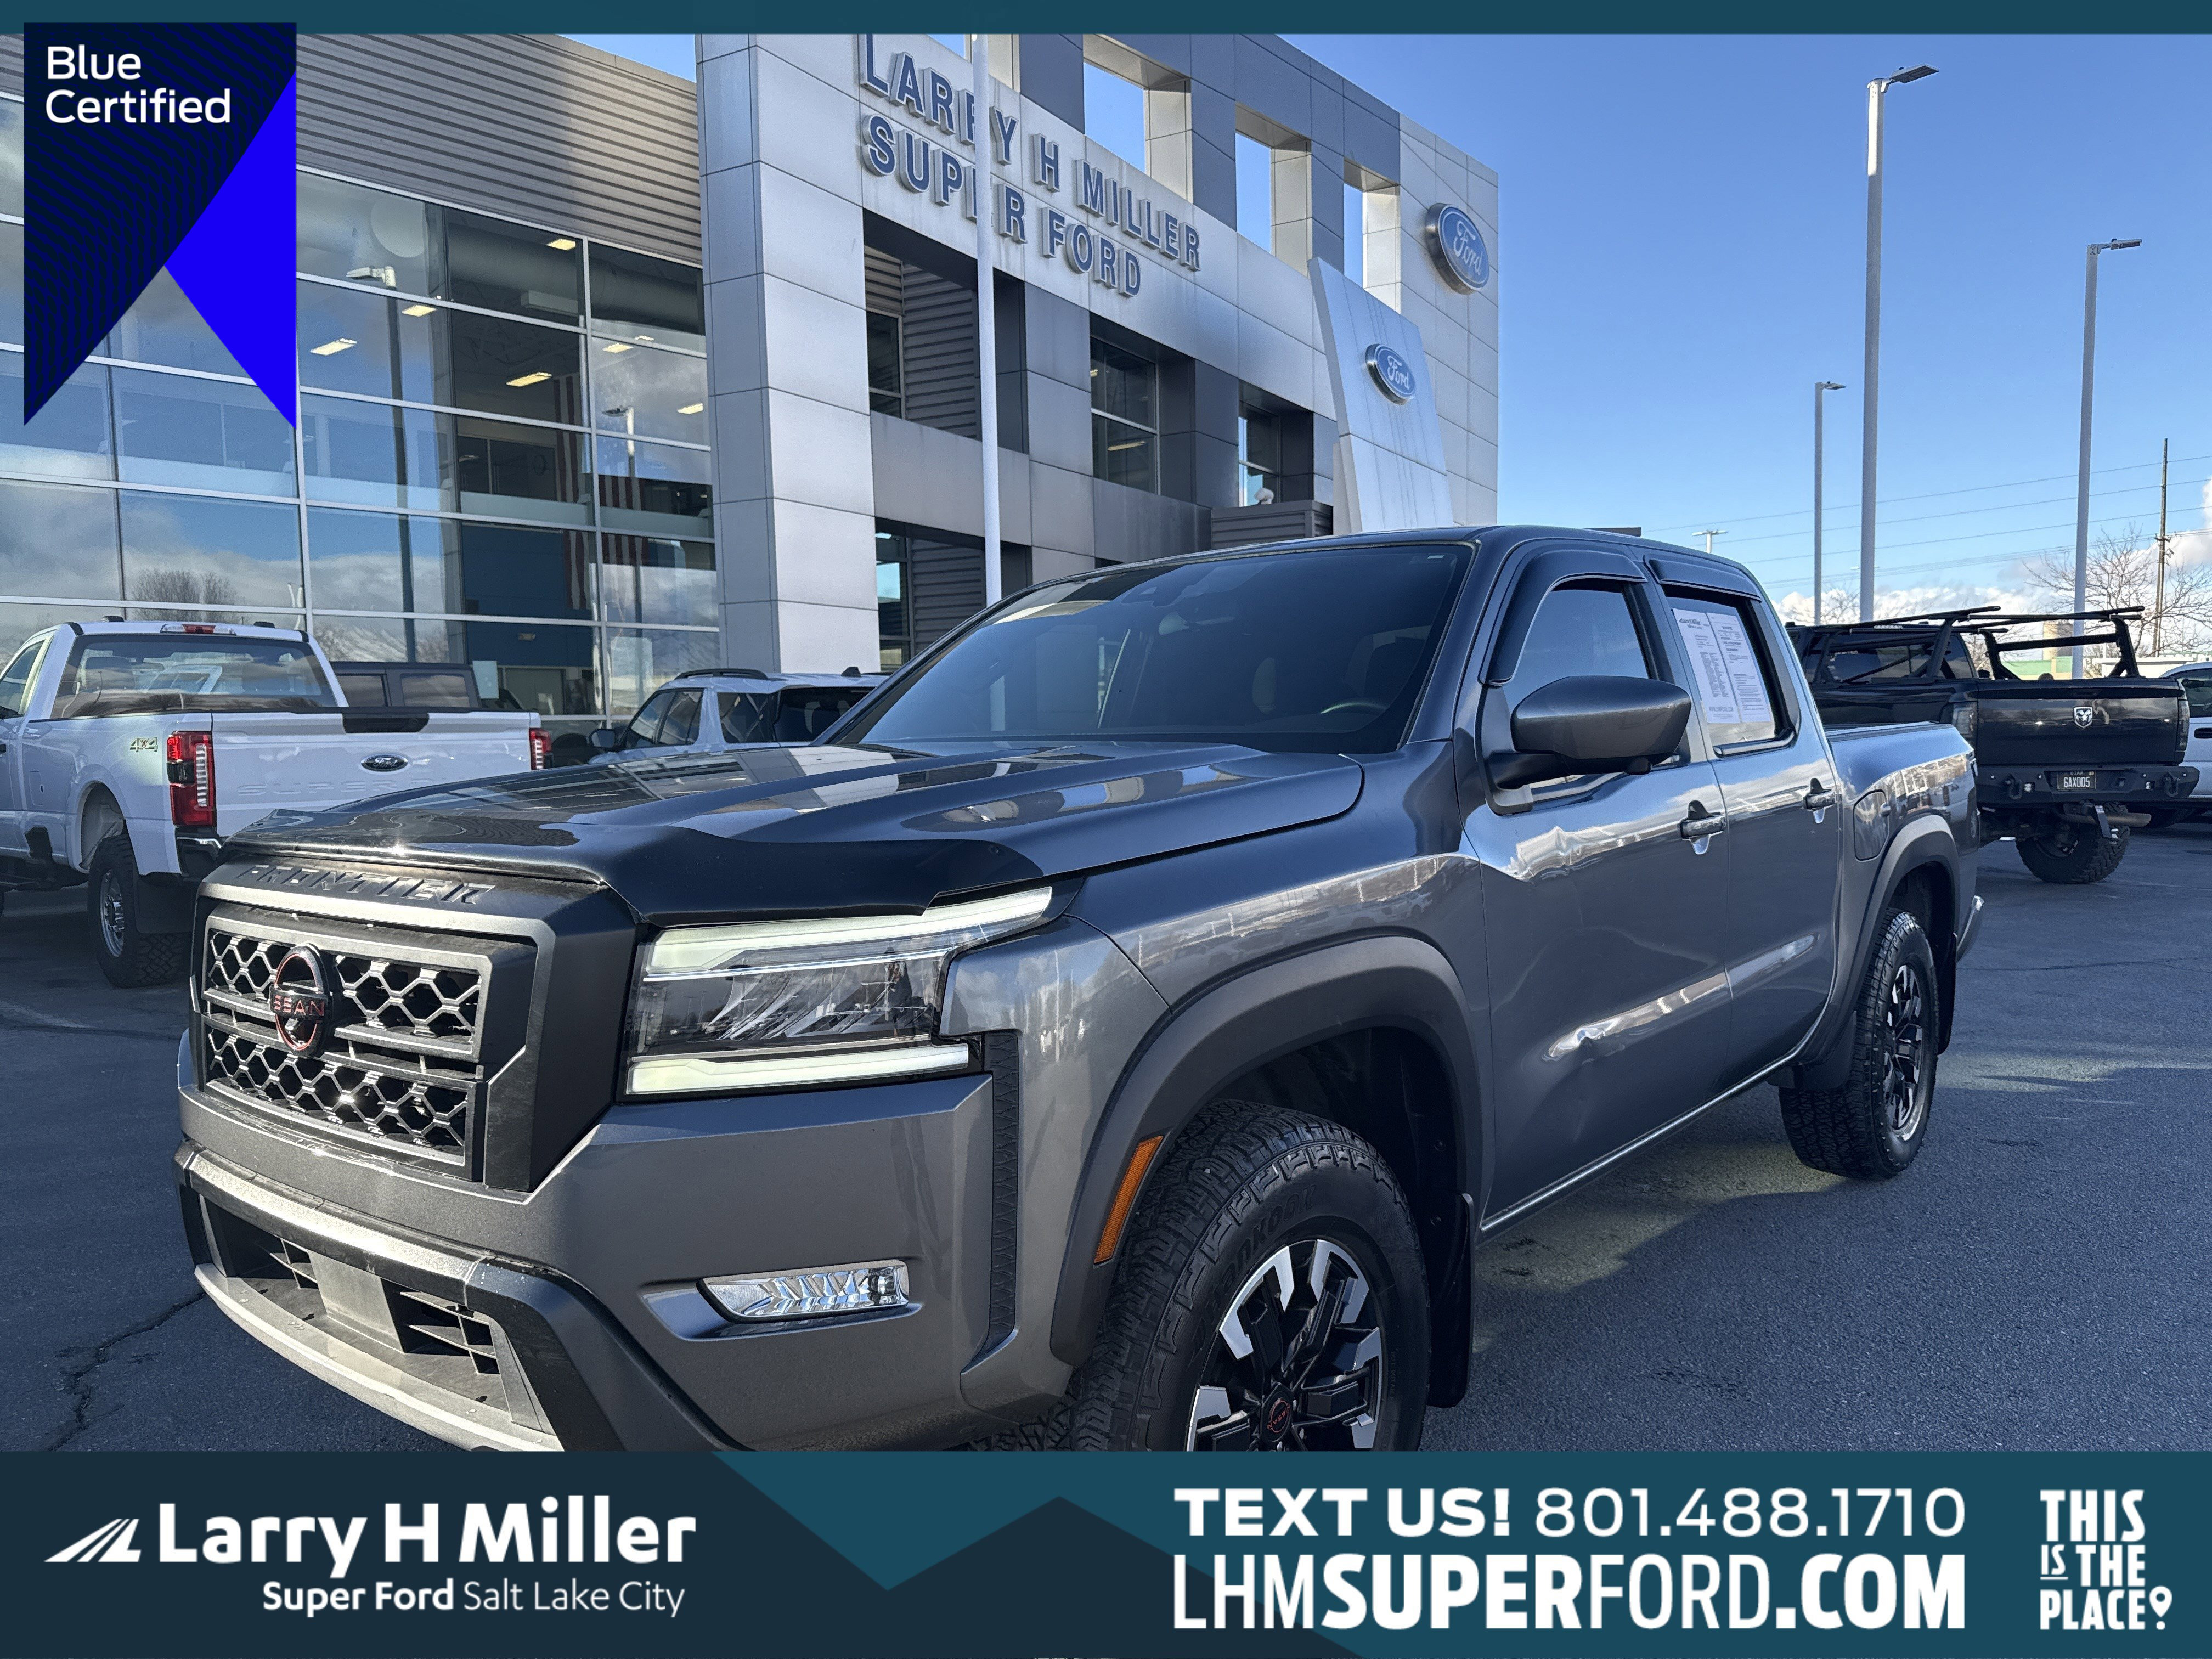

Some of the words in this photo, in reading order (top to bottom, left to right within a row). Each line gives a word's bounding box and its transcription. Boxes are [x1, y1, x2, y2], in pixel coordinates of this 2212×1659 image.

[862, 115, 1027, 244] SUPR
[1042, 207, 1141, 297] FORD
[1034, 133, 1060, 192] H
[1076, 159, 1200, 271] MILLER
[1454, 221, 1483, 275] Ford
[1387, 355, 1409, 390] Ford
[238, 780, 397, 797] SUPER
[2063, 776, 2090, 788] 6AX005
[237, 864, 496, 905] FRONTIER
